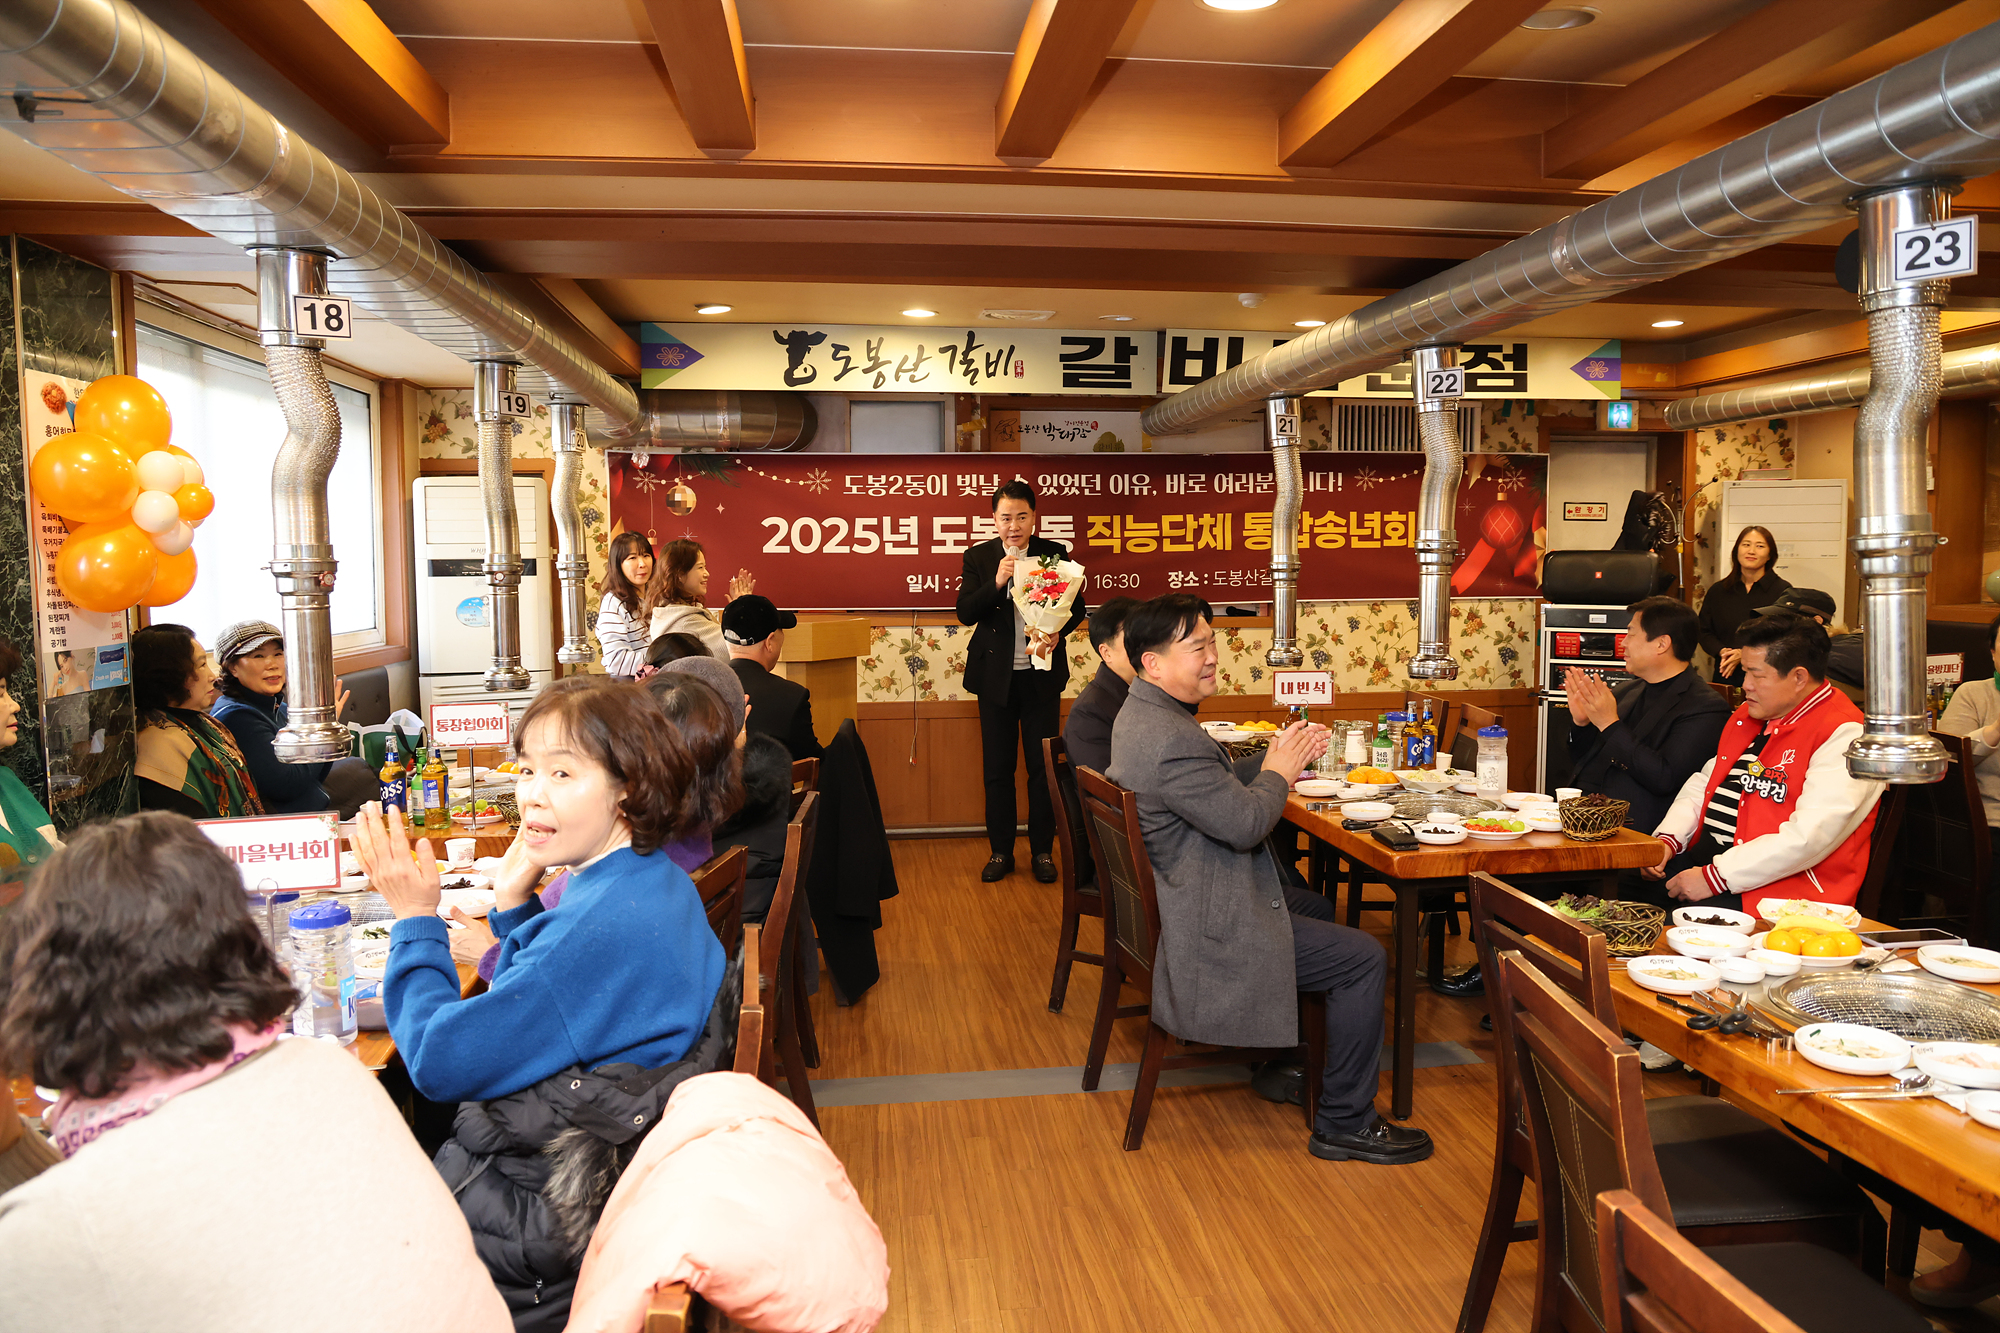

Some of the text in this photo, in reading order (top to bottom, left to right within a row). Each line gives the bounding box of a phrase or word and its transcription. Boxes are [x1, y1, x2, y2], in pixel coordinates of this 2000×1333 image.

[1905, 231, 1961, 271] 23
[303, 302, 344, 332] 18
[831, 331, 1015, 389] 도봉산 갈비
[1431, 373, 1458, 394] 22
[504, 395, 526, 413] 19
[1018, 424, 1040, 434] 도봉산
[1043, 422, 1091, 442] 박대감
[1279, 418, 1293, 433] 21
[843, 474, 948, 496] 도봉2동이
[957, 474, 1000, 497] 빛날
[1038, 473, 1101, 497] 있었던
[1109, 473, 1157, 496] 이유,
[1166, 473, 1207, 495] 바로
[761, 515, 919, 555] 2025년
[931, 515, 1076, 554] 도봉동
[1086, 513, 1232, 553] 직능단체
[906, 574, 939, 593] 일시
[1094, 574, 1140, 589] 16:30
[1168, 571, 1200, 589] 장소
[1281, 681, 1325, 695] 내빈석
[435, 716, 504, 732] 통장협의회
[1763, 769, 1786, 783] 의장
[1740, 774, 1787, 803] 안병건
[223, 840, 329, 863] 마을부녀회
